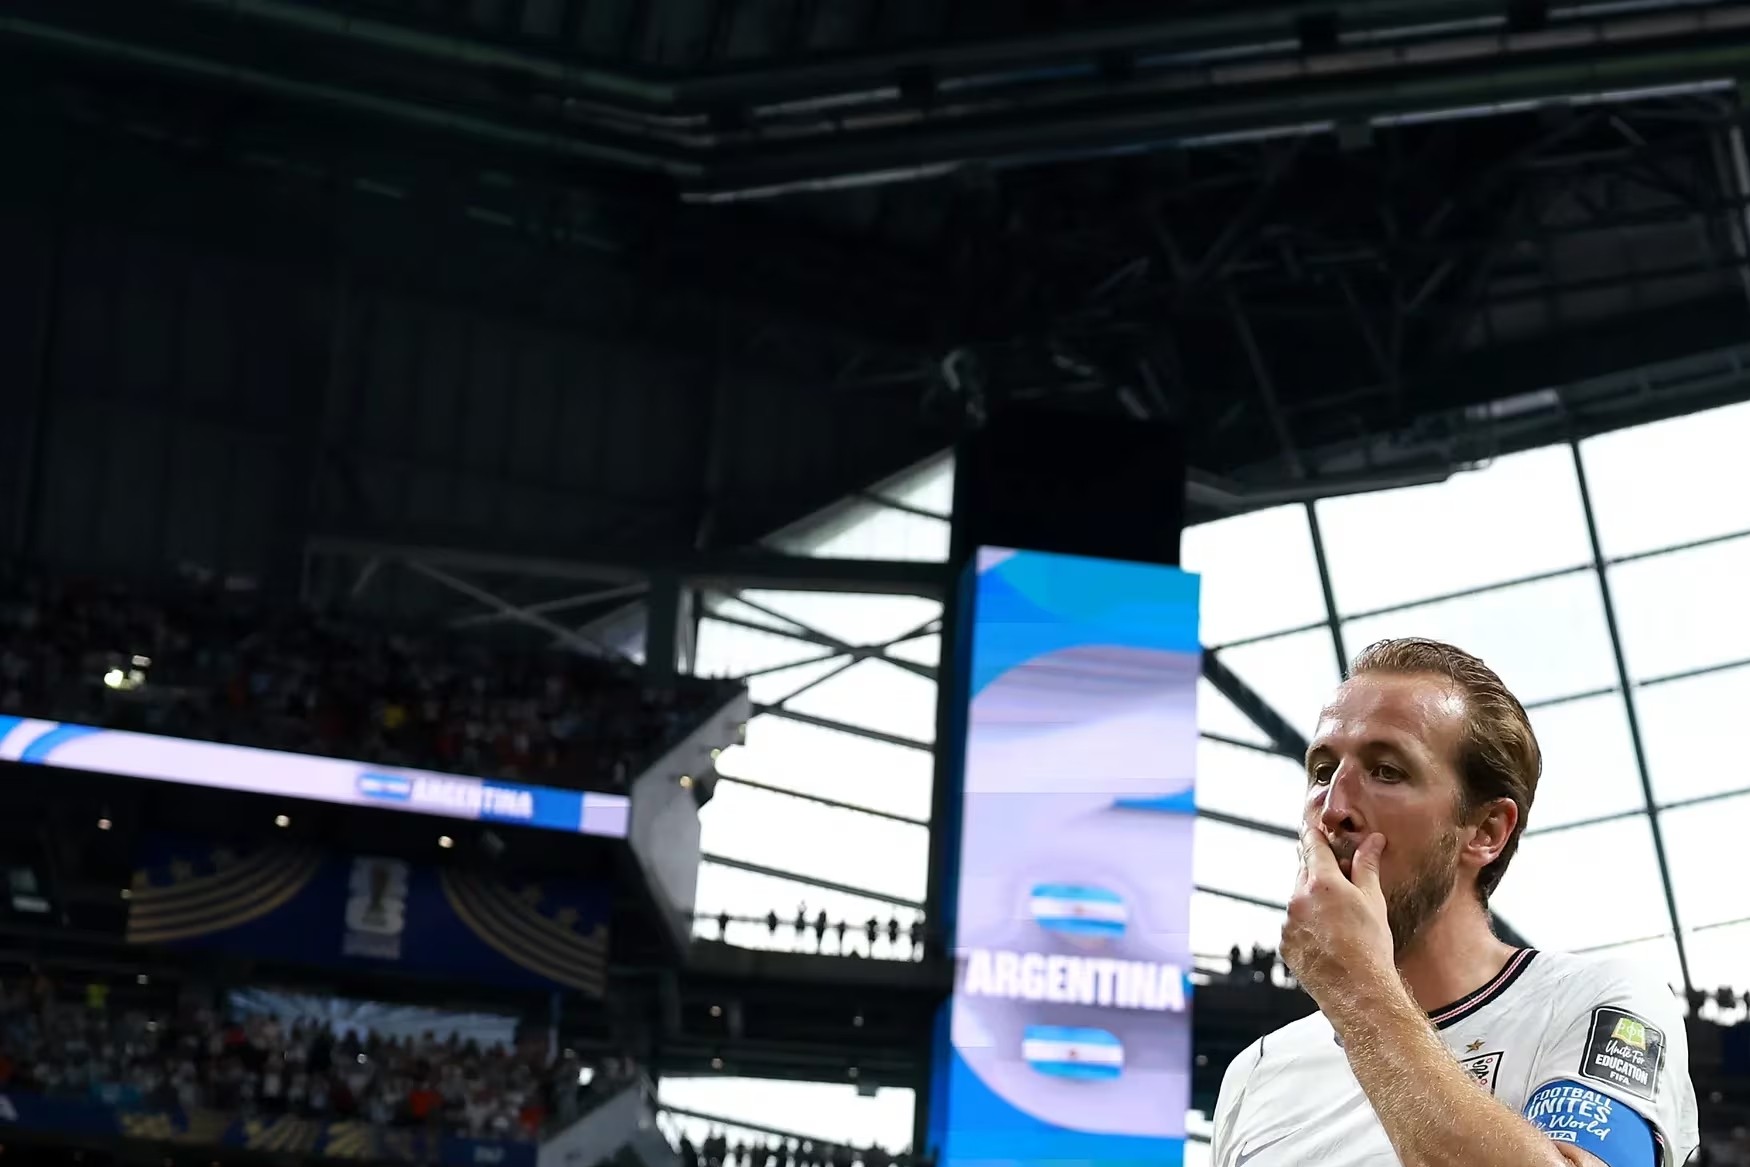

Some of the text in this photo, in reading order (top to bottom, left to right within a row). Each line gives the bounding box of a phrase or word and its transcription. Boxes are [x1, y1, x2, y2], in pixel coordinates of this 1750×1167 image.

[964, 949, 1186, 1012] ARGENTINA
[1605, 1040, 1646, 1065] Unite For
[1595, 1053, 1649, 1086] EDUCATION
[1609, 1070, 1631, 1085] FIFA
[1528, 1096, 1610, 1123] UNITES
[1533, 1086, 1612, 1111] FOOTBALL
[1548, 1114, 1612, 1142] World
